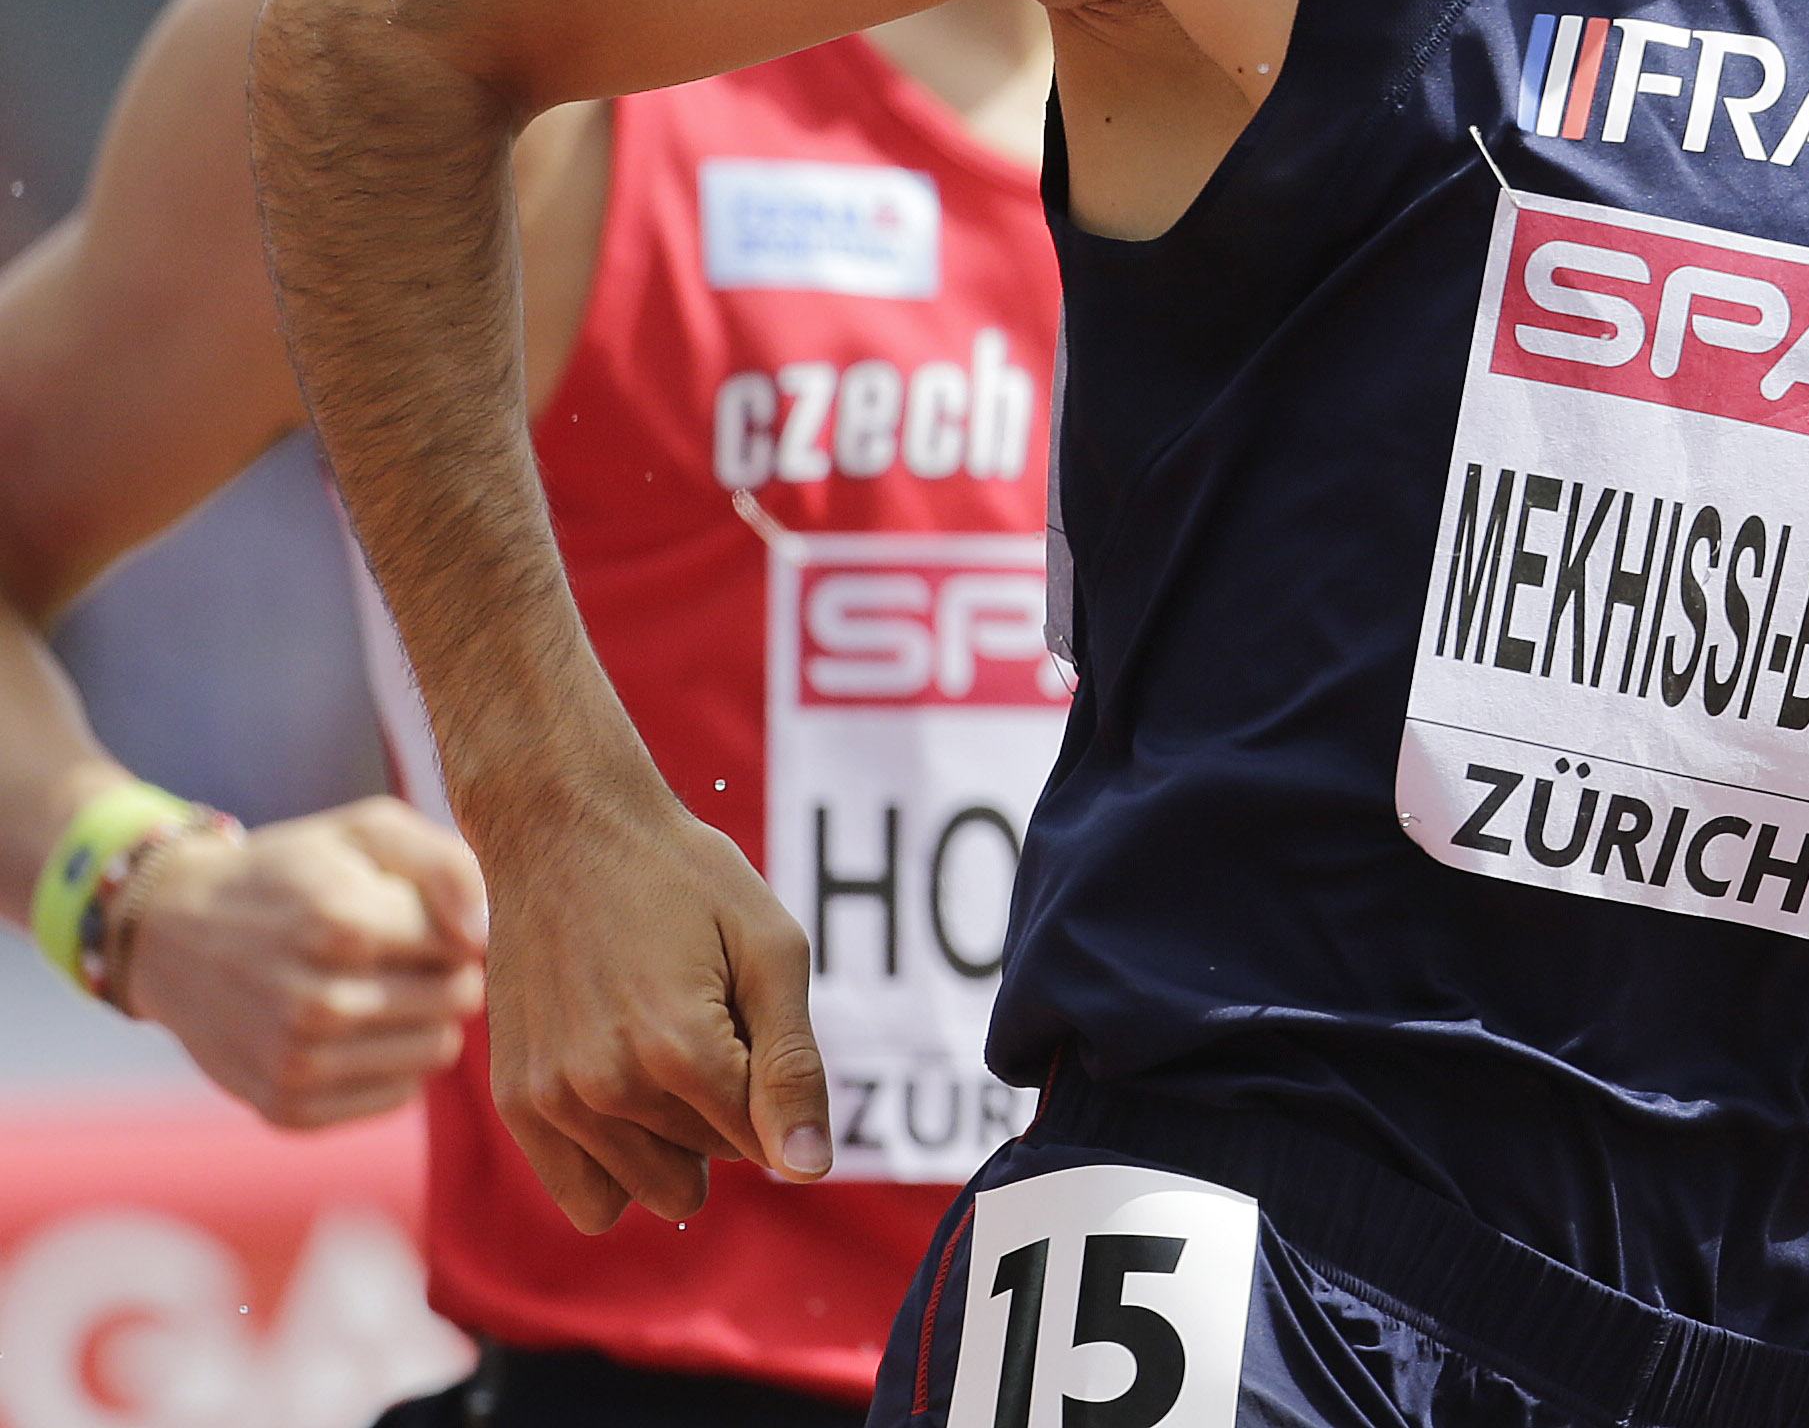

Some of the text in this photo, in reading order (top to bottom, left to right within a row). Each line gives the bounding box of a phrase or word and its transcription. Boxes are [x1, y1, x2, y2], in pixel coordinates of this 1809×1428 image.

[713, 326, 1036, 490] czech
[805, 570, 1080, 700] SP
[988, 1232, 1190, 1428] 15
